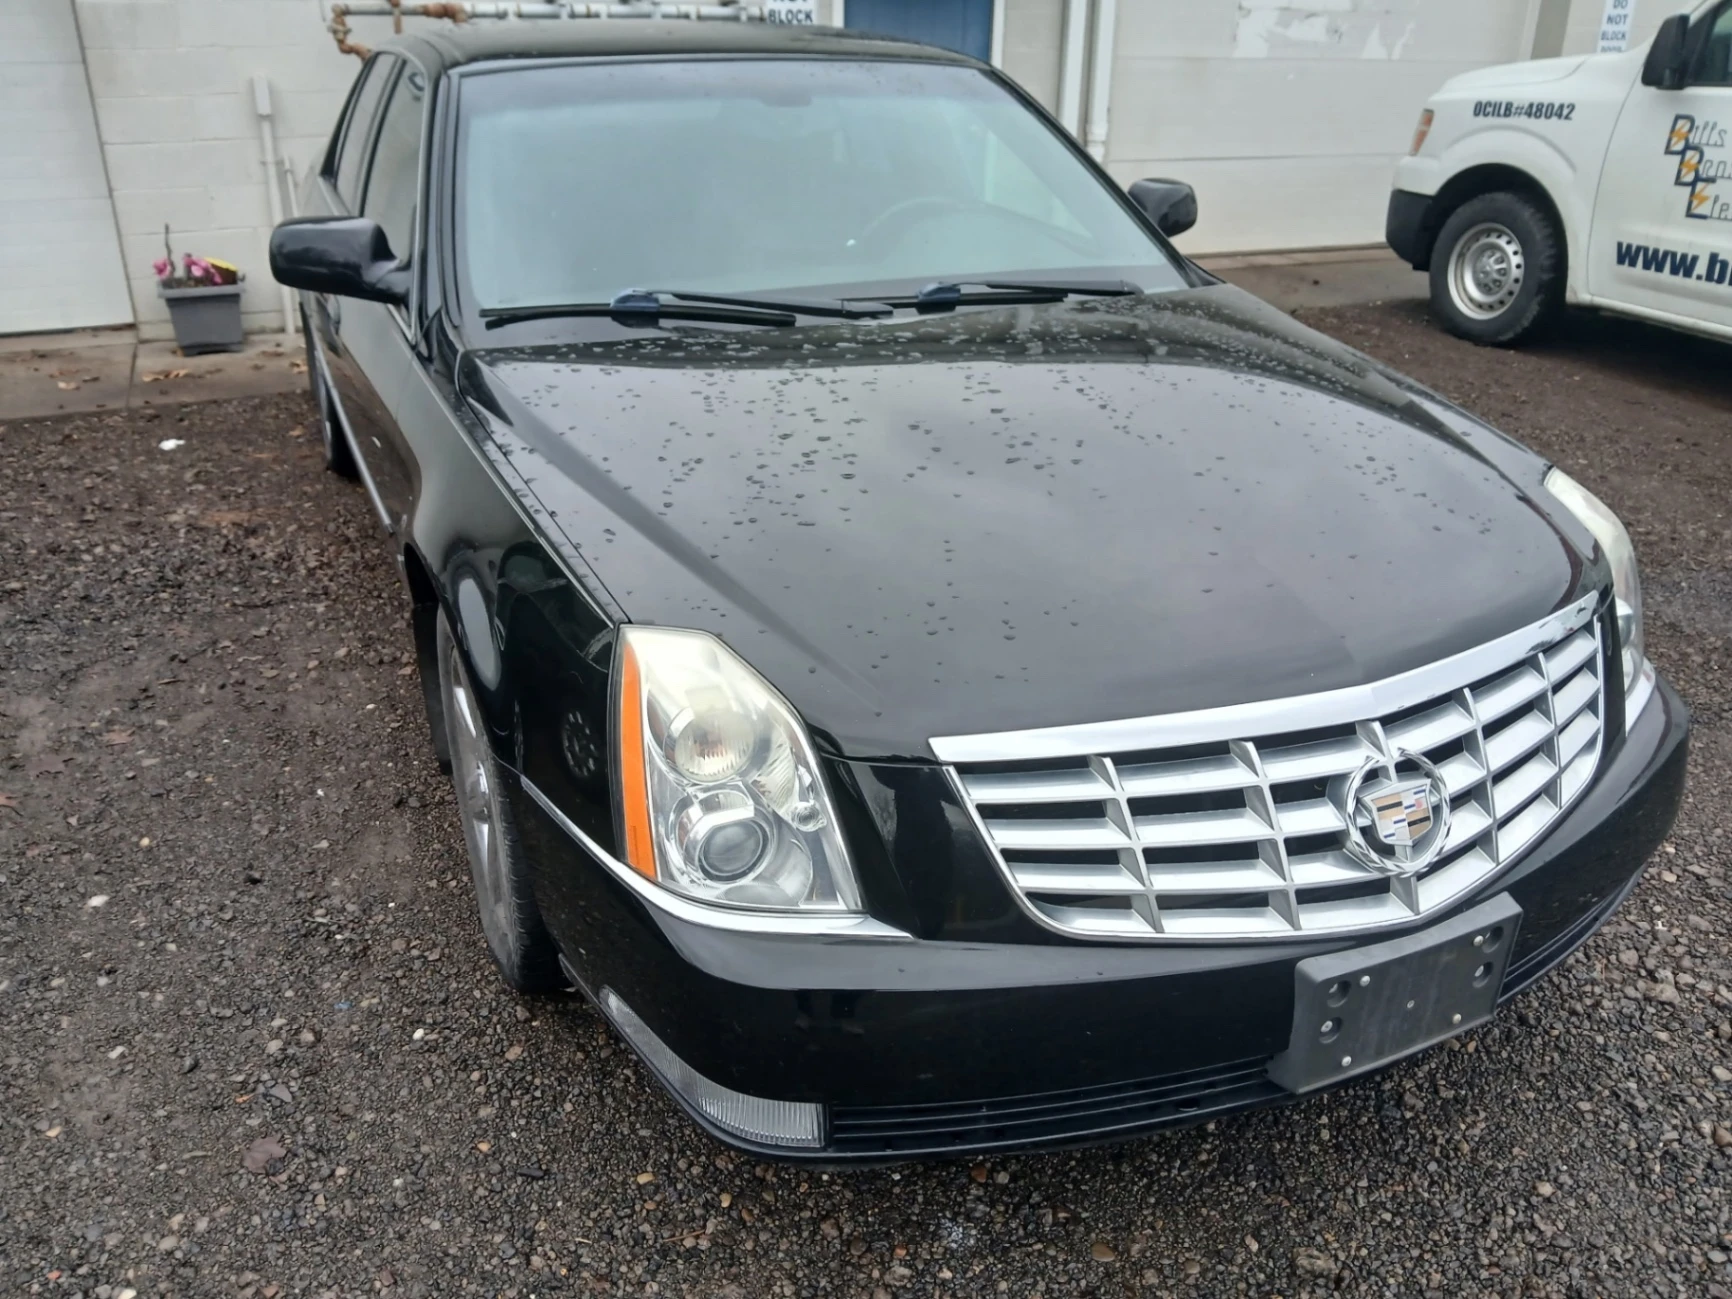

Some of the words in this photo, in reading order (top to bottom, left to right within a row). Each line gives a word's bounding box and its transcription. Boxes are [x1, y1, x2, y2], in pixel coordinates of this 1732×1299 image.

[768, 9, 813, 24] BLOCK
[1606, 14, 1628, 25] NOT
[1601, 31, 1626, 41] BLOCK
[1473, 100, 1576, 121] OCILB#48042
[1664, 113, 1727, 155] Bills
[1615, 240, 1732, 286] www.b
